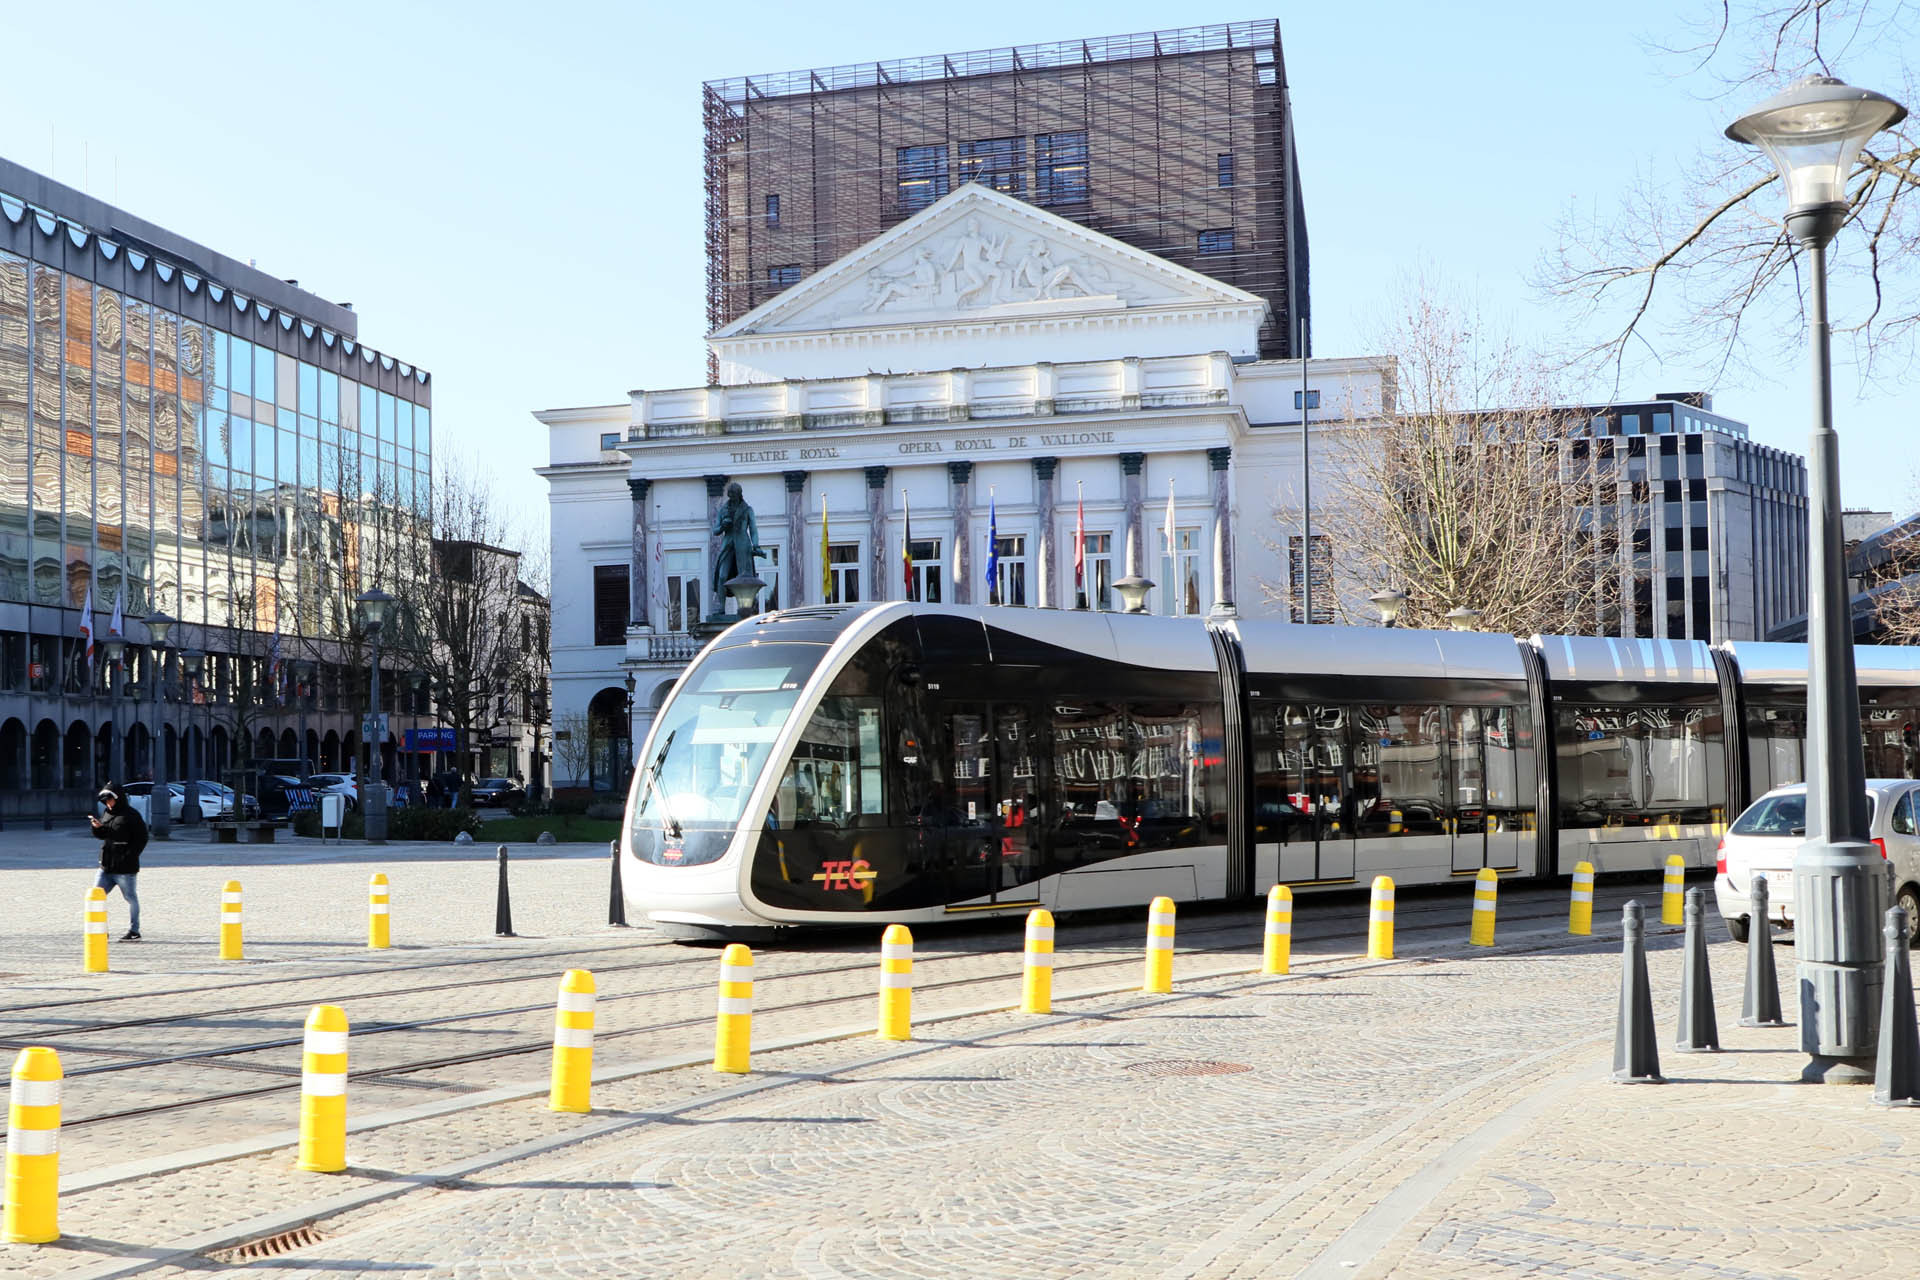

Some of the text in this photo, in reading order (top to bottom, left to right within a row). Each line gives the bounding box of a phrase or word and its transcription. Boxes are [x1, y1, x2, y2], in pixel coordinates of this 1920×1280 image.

[898, 431, 1115, 454] OPERA ROYAL DE WALLONIE
[730, 447, 840, 463] THEATRE ROYAL
[418, 731, 453, 739] PARKNG
[822, 860, 871, 891] TEC
